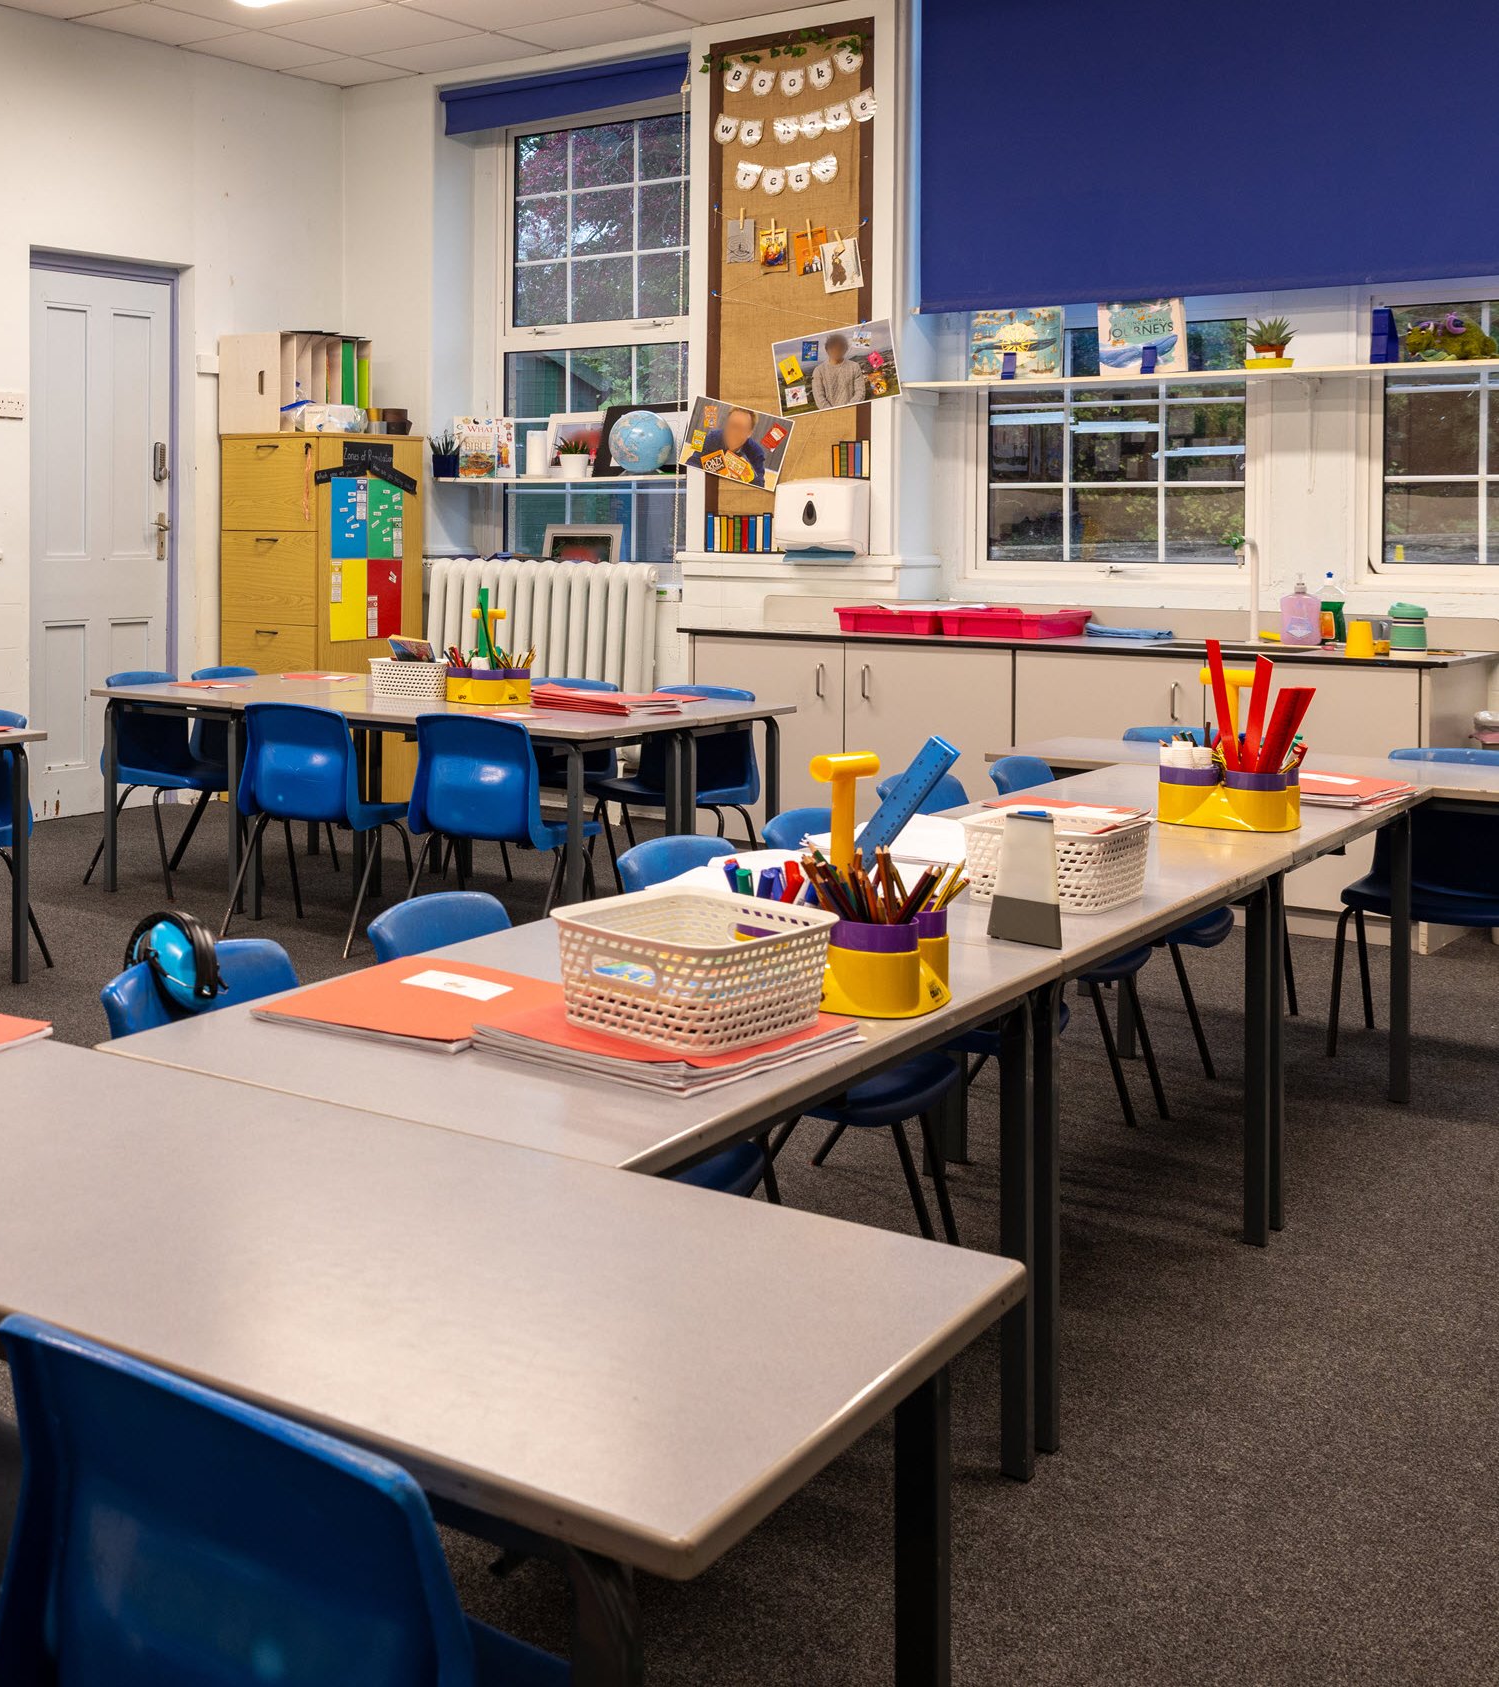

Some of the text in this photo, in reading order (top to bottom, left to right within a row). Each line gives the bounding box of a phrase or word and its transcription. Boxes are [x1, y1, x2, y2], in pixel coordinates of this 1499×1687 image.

[732, 54, 853, 88] Books
[721, 124, 754, 138] we
[1108, 321, 1174, 341] JOURNEYS
[467, 425, 493, 433] WHAT
[465, 442, 491, 451] BIBLE
[343, 447, 359, 461] Zones
[360, 449, 367, 461] of
